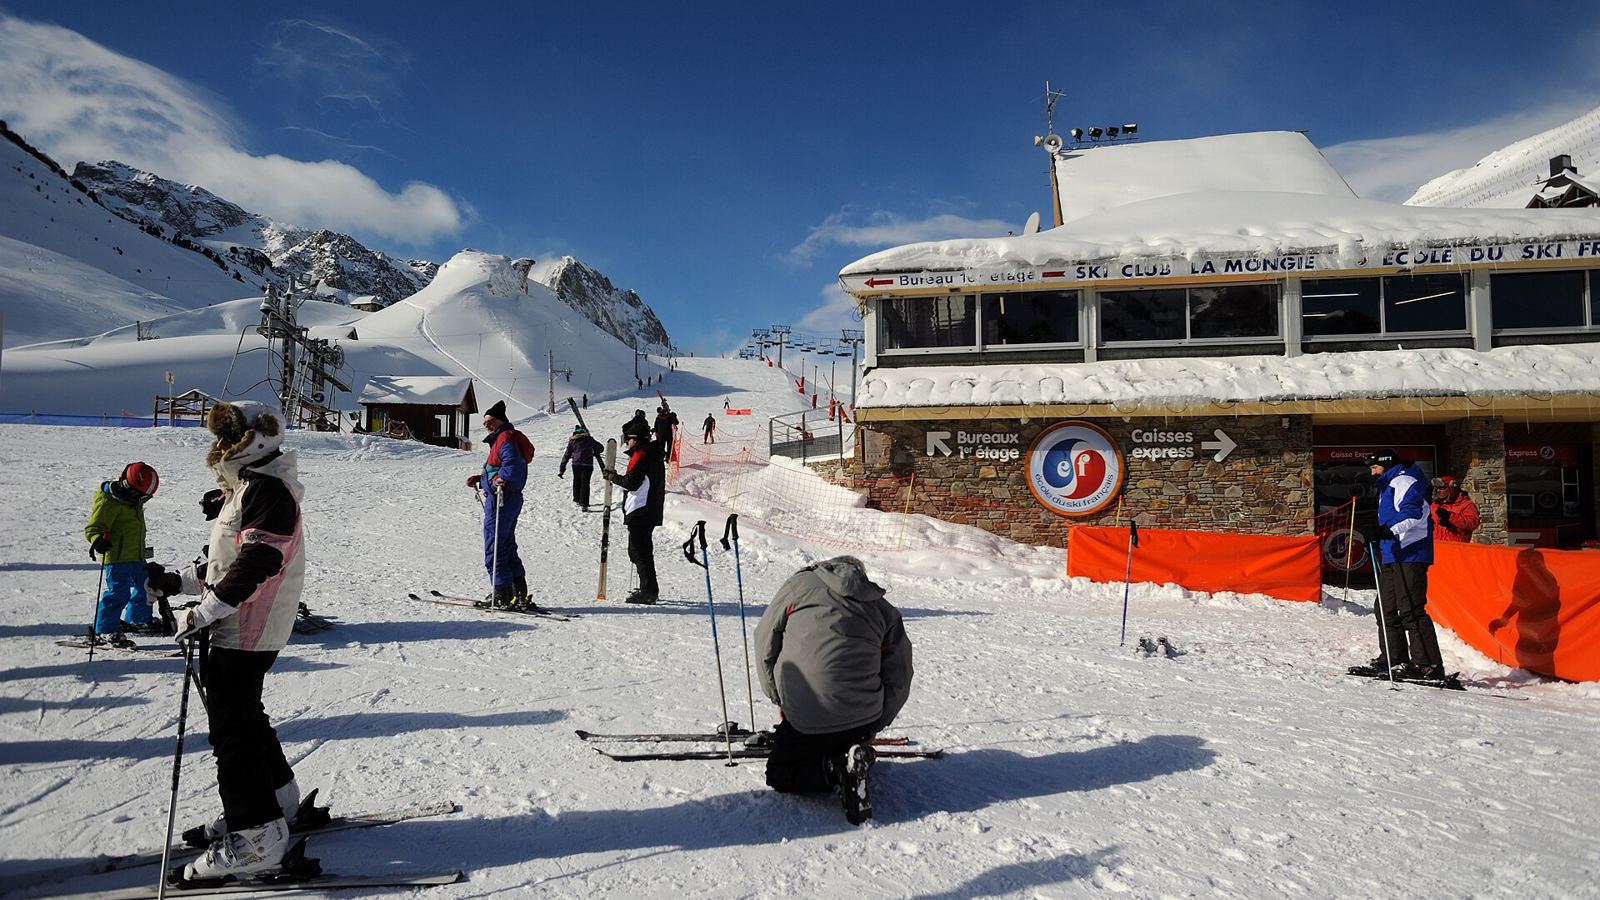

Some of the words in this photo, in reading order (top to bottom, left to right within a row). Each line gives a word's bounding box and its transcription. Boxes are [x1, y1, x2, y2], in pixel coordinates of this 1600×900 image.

[1470, 246, 1503, 262] DU
[1522, 243, 1562, 259] SKI
[1076, 265, 1108, 279] SKI
[1121, 262, 1171, 277] CLUB
[1191, 260, 1216, 275] LA
[1224, 256, 1316, 273] MONGIE
[900, 272, 953, 286] Bureau
[957, 430, 1020, 444] Bureaux
[1131, 428, 1194, 443] Caisses
[958, 445, 973, 459] 1er
[975, 444, 1020, 462] étage
[1132, 446, 1195, 462] express
[1508, 449, 1538, 459] Express
